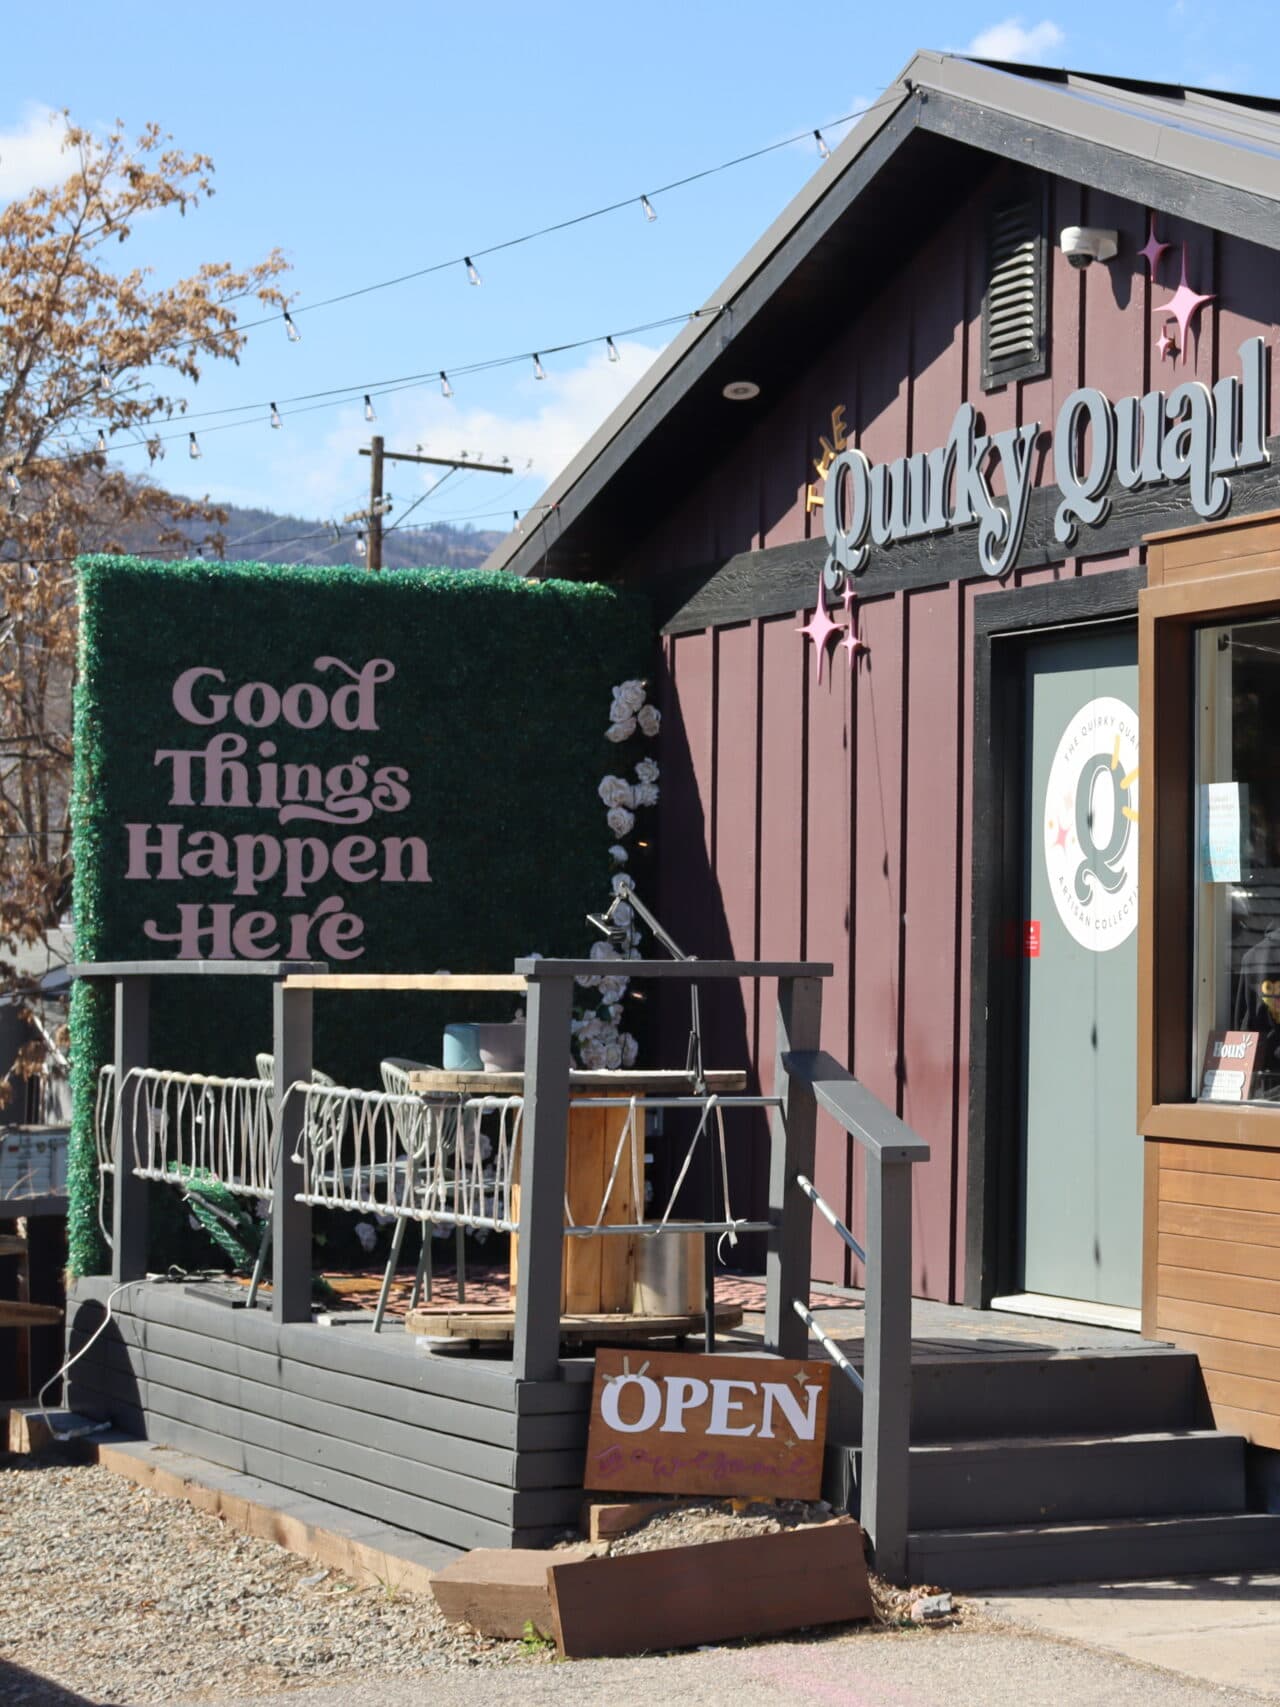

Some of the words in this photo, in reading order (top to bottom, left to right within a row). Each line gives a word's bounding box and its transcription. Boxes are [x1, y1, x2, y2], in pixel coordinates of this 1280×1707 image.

[823, 401, 1042, 592] Quirky
[1053, 336, 1272, 544] Quail
[171, 656, 395, 731] Good
[1081, 716, 1115, 736] QUIRKY
[1119, 721, 1138, 750] QUAI
[153, 732, 411, 826] Things
[123, 824, 433, 898] Happen
[1074, 753, 1131, 907] Q
[143, 896, 366, 960] Here
[1095, 891, 1136, 930] COLLECTI
[1213, 1042, 1246, 1059] Hours
[601, 1374, 823, 1441] OPEN
